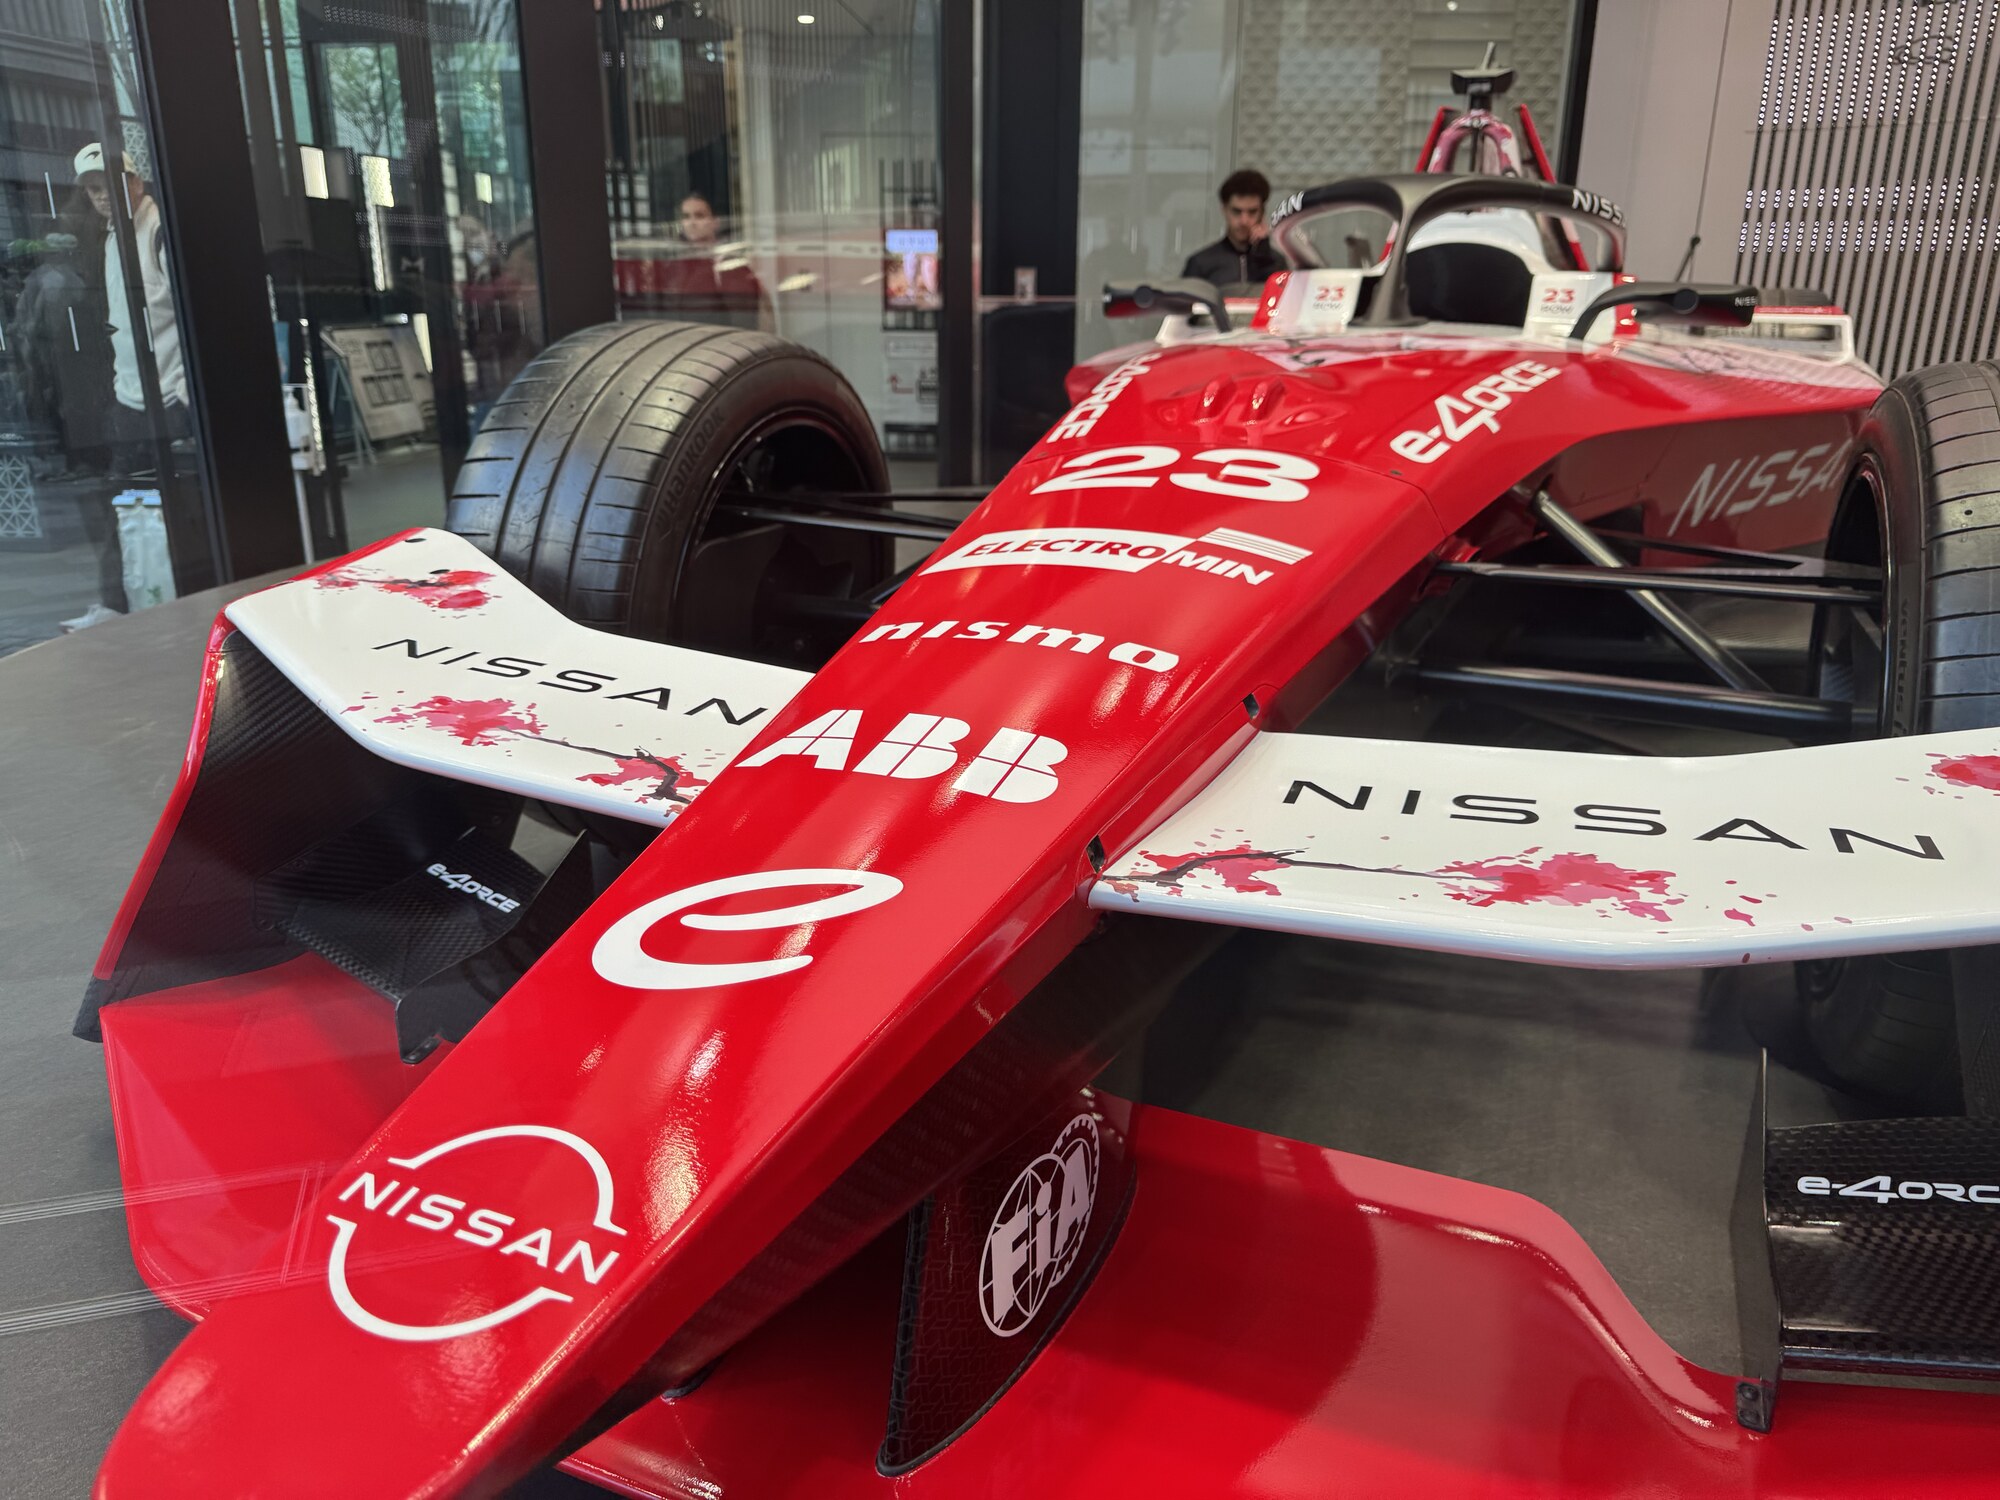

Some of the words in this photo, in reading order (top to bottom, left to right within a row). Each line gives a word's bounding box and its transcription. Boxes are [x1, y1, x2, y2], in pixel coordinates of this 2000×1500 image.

[1572, 189, 1626, 227] NISS
[1315, 285, 1346, 302] 23
[1541, 287, 1576, 303] 23
[1029, 445, 1321, 503] 23
[858, 620, 1180, 673] nismo
[371, 638, 769, 727] NISSAN
[734, 708, 1069, 804] ABB
[1282, 779, 1946, 861] NISSAN
[338, 1171, 621, 1286] NISSAN
